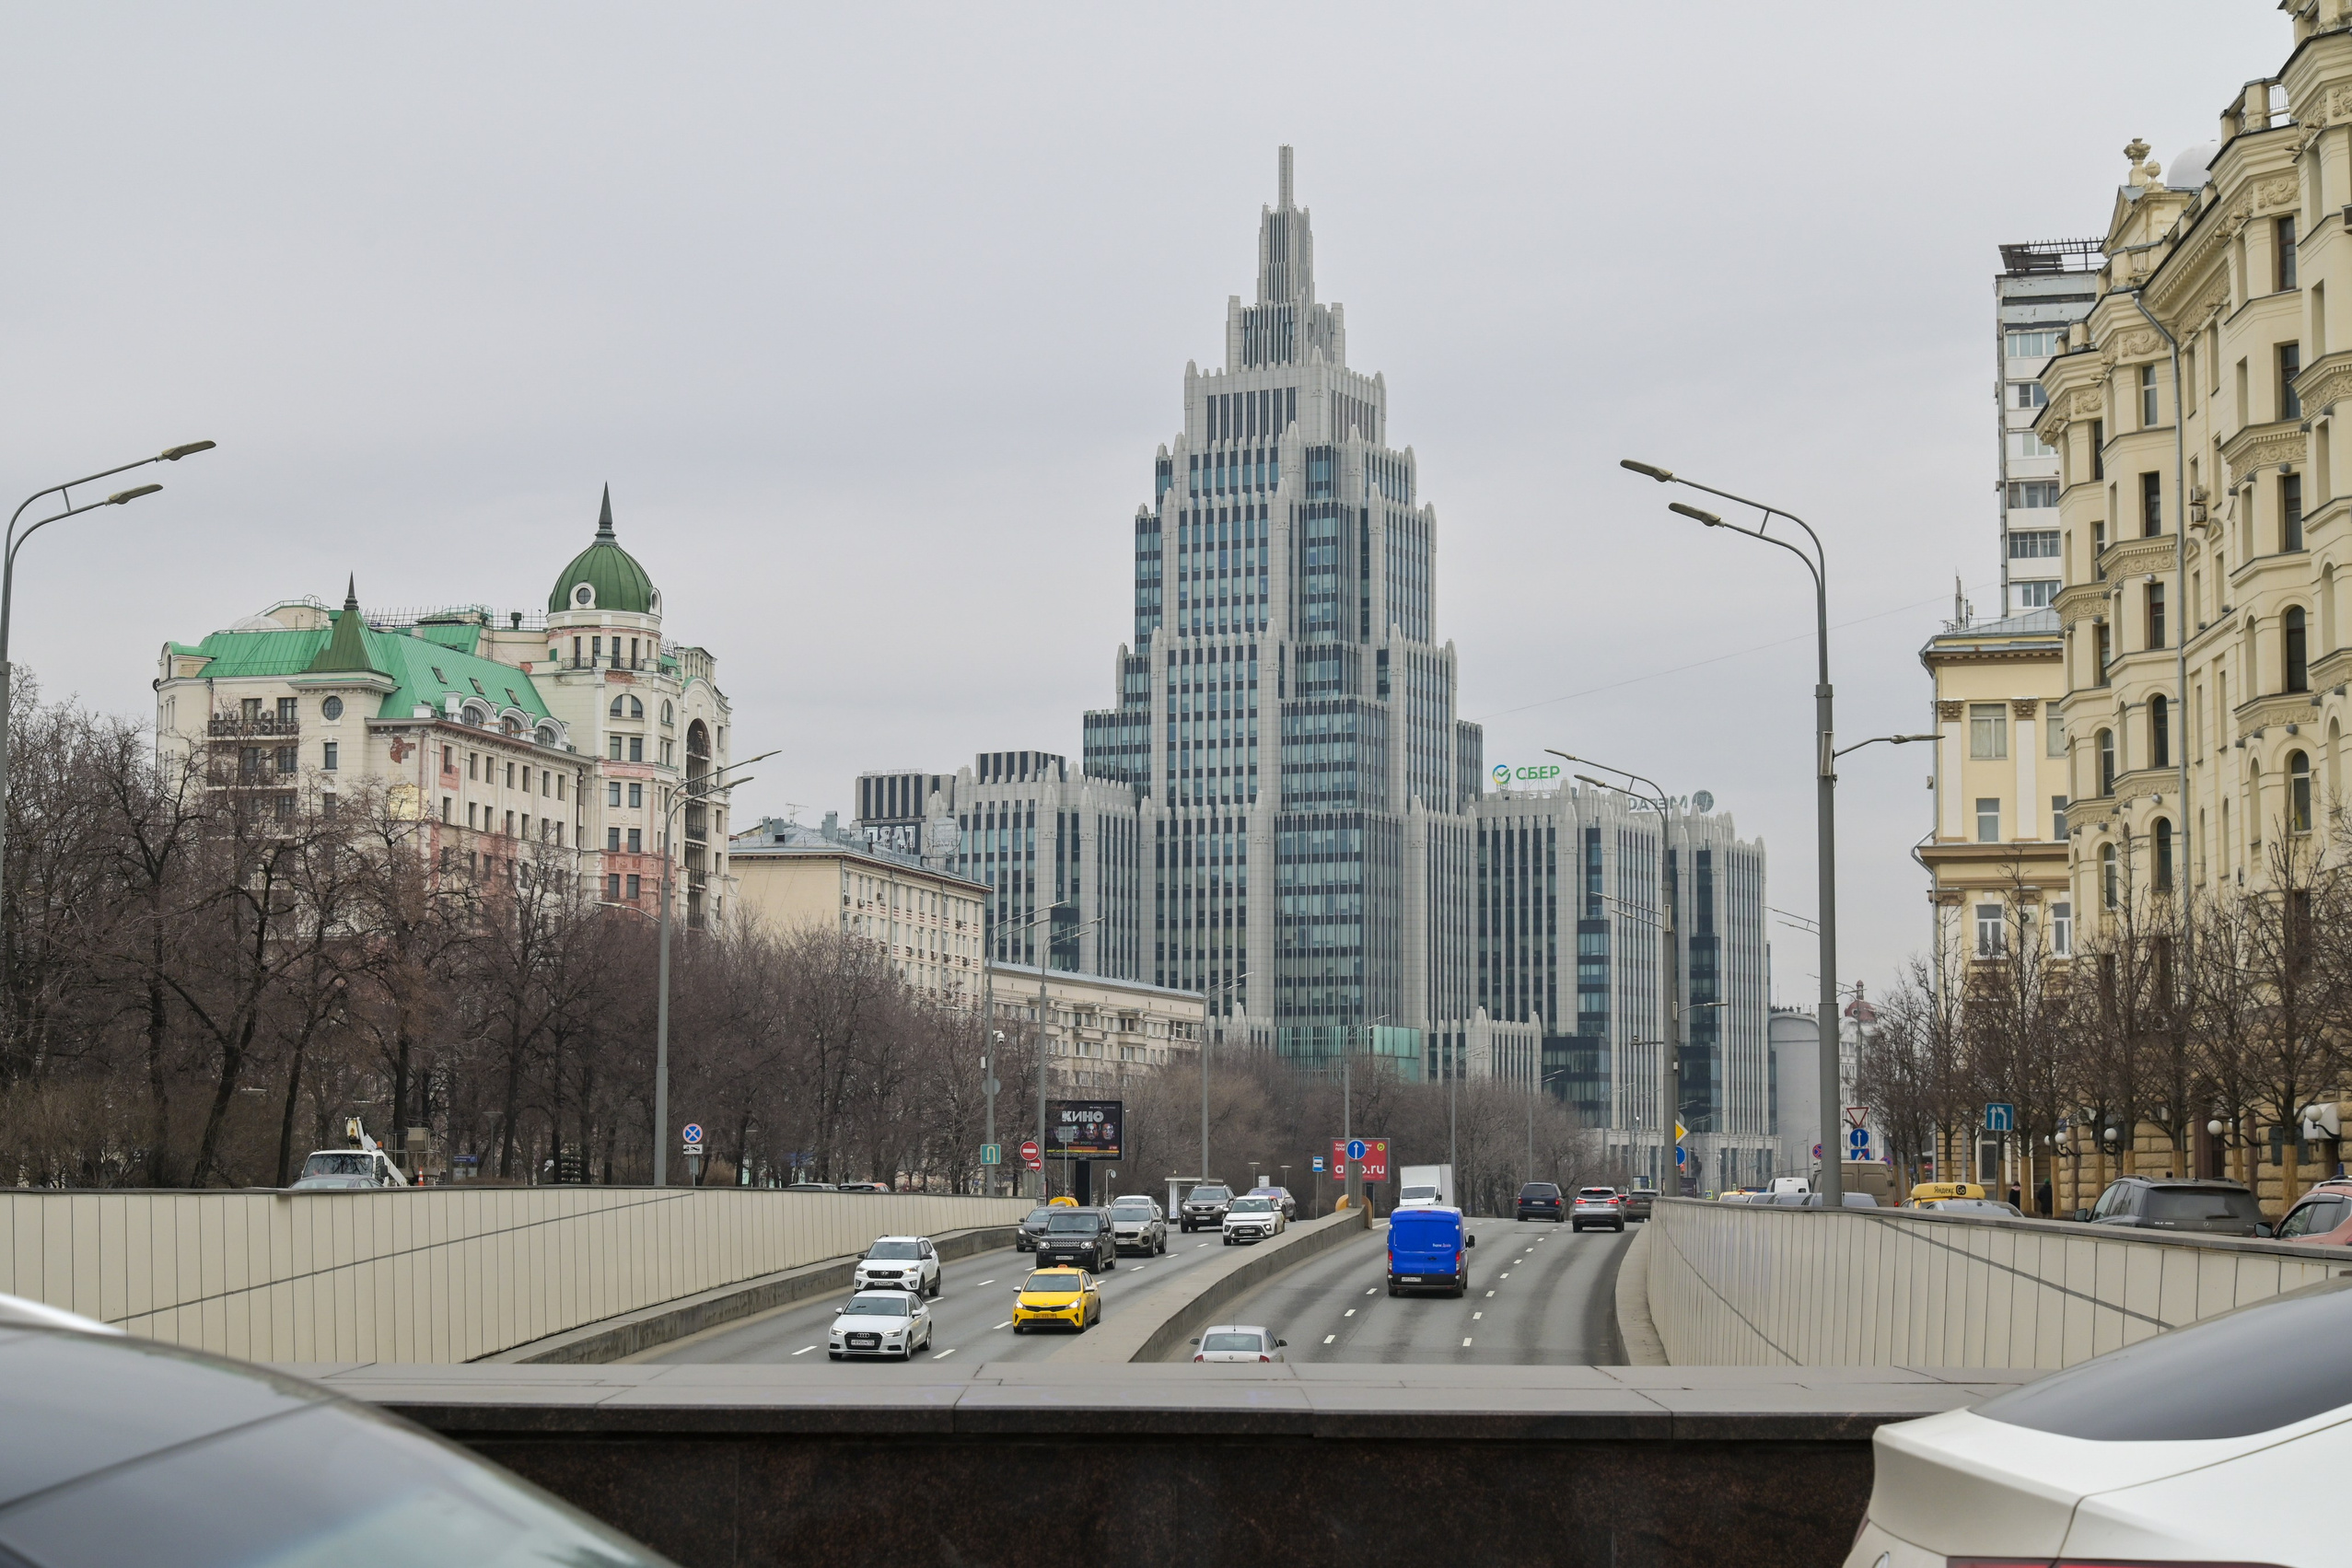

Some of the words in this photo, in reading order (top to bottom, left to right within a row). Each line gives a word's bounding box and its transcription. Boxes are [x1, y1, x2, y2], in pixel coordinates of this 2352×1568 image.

[1516, 765, 1560, 780] СБЕР
[1061, 1110, 1104, 1122] КИНО
[1934, 1186, 1954, 1194] Яндекс
[1957, 1185, 1965, 1194] Go
